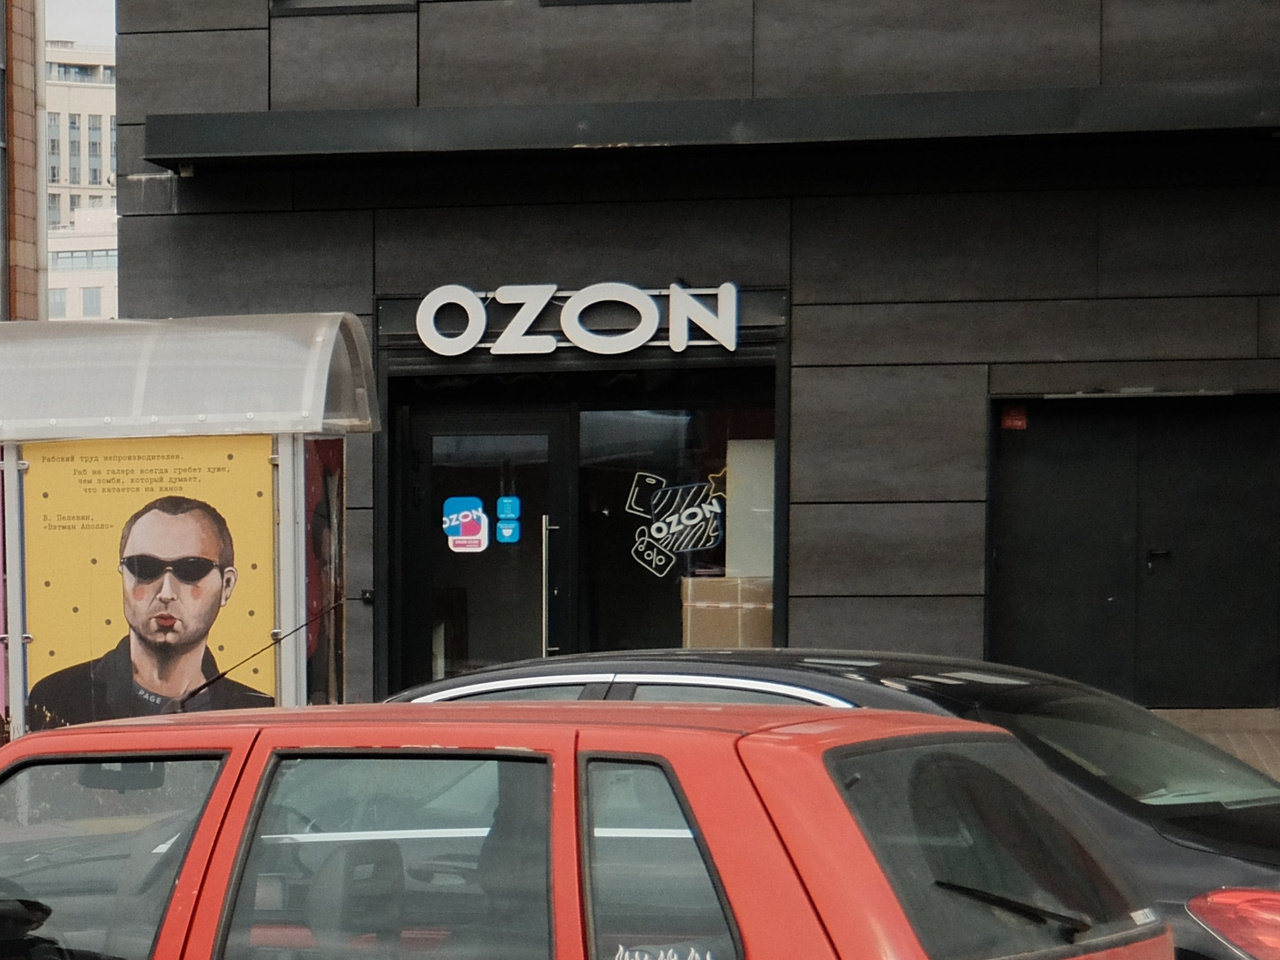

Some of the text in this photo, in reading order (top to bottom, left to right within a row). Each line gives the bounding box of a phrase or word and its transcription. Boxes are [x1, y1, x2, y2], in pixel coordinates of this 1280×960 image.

[416, 282, 737, 356] OZON
[41, 455, 75, 463] Рабский
[103, 454, 184, 462] непроизводителен.
[130, 476, 164, 484] который
[168, 476, 202, 484] думает,
[56, 514, 94, 522] Пелевин,
[650, 498, 722, 538] OZON
[138, 689, 162, 704] PAGE
